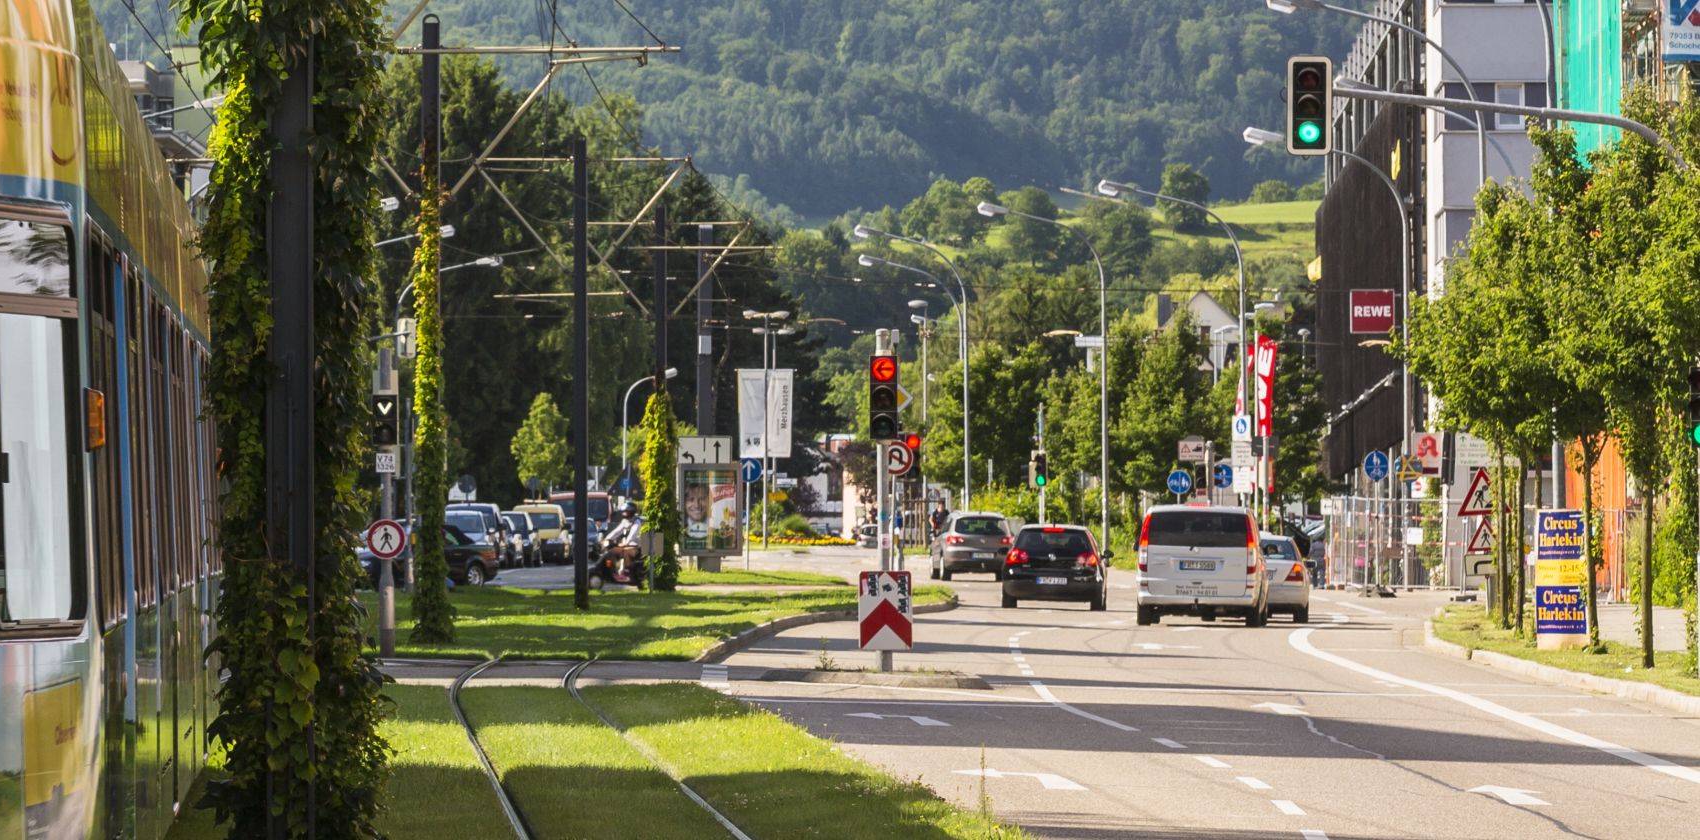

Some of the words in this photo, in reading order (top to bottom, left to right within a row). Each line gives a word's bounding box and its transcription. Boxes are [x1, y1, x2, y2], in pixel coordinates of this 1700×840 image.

[1354, 305, 1392, 318] REWE
[1543, 516, 1578, 530] Circus
[1539, 532, 1584, 547] Harlekin
[1542, 589, 1578, 604] Circus
[1538, 606, 1585, 621] Harlekin
